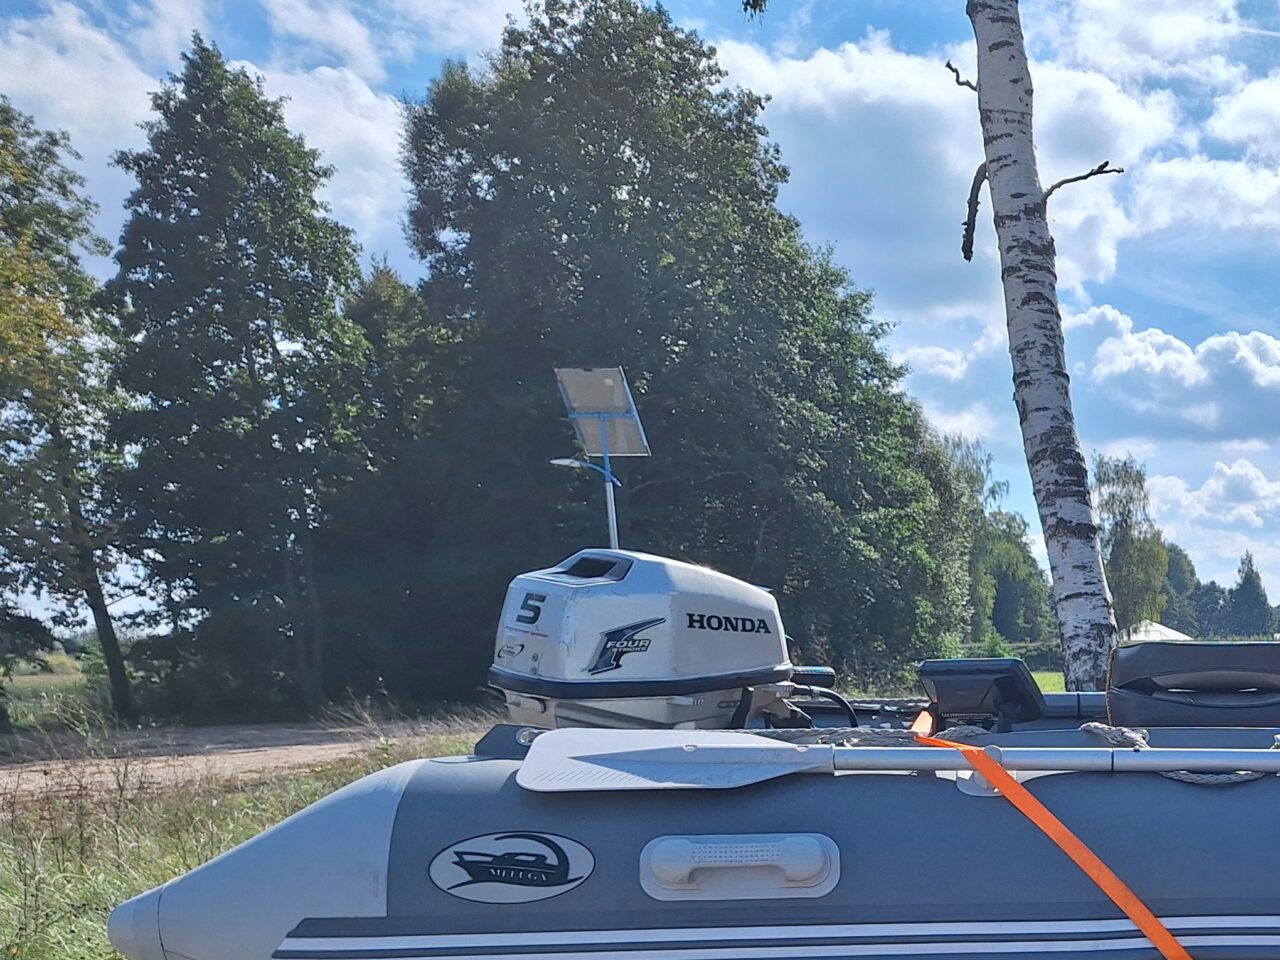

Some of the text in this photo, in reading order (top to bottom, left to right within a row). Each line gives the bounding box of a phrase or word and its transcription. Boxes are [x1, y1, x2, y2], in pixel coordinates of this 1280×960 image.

[515, 591, 547, 625] 5
[686, 613, 772, 634] HONDA
[606, 640, 650, 648] FOUR
